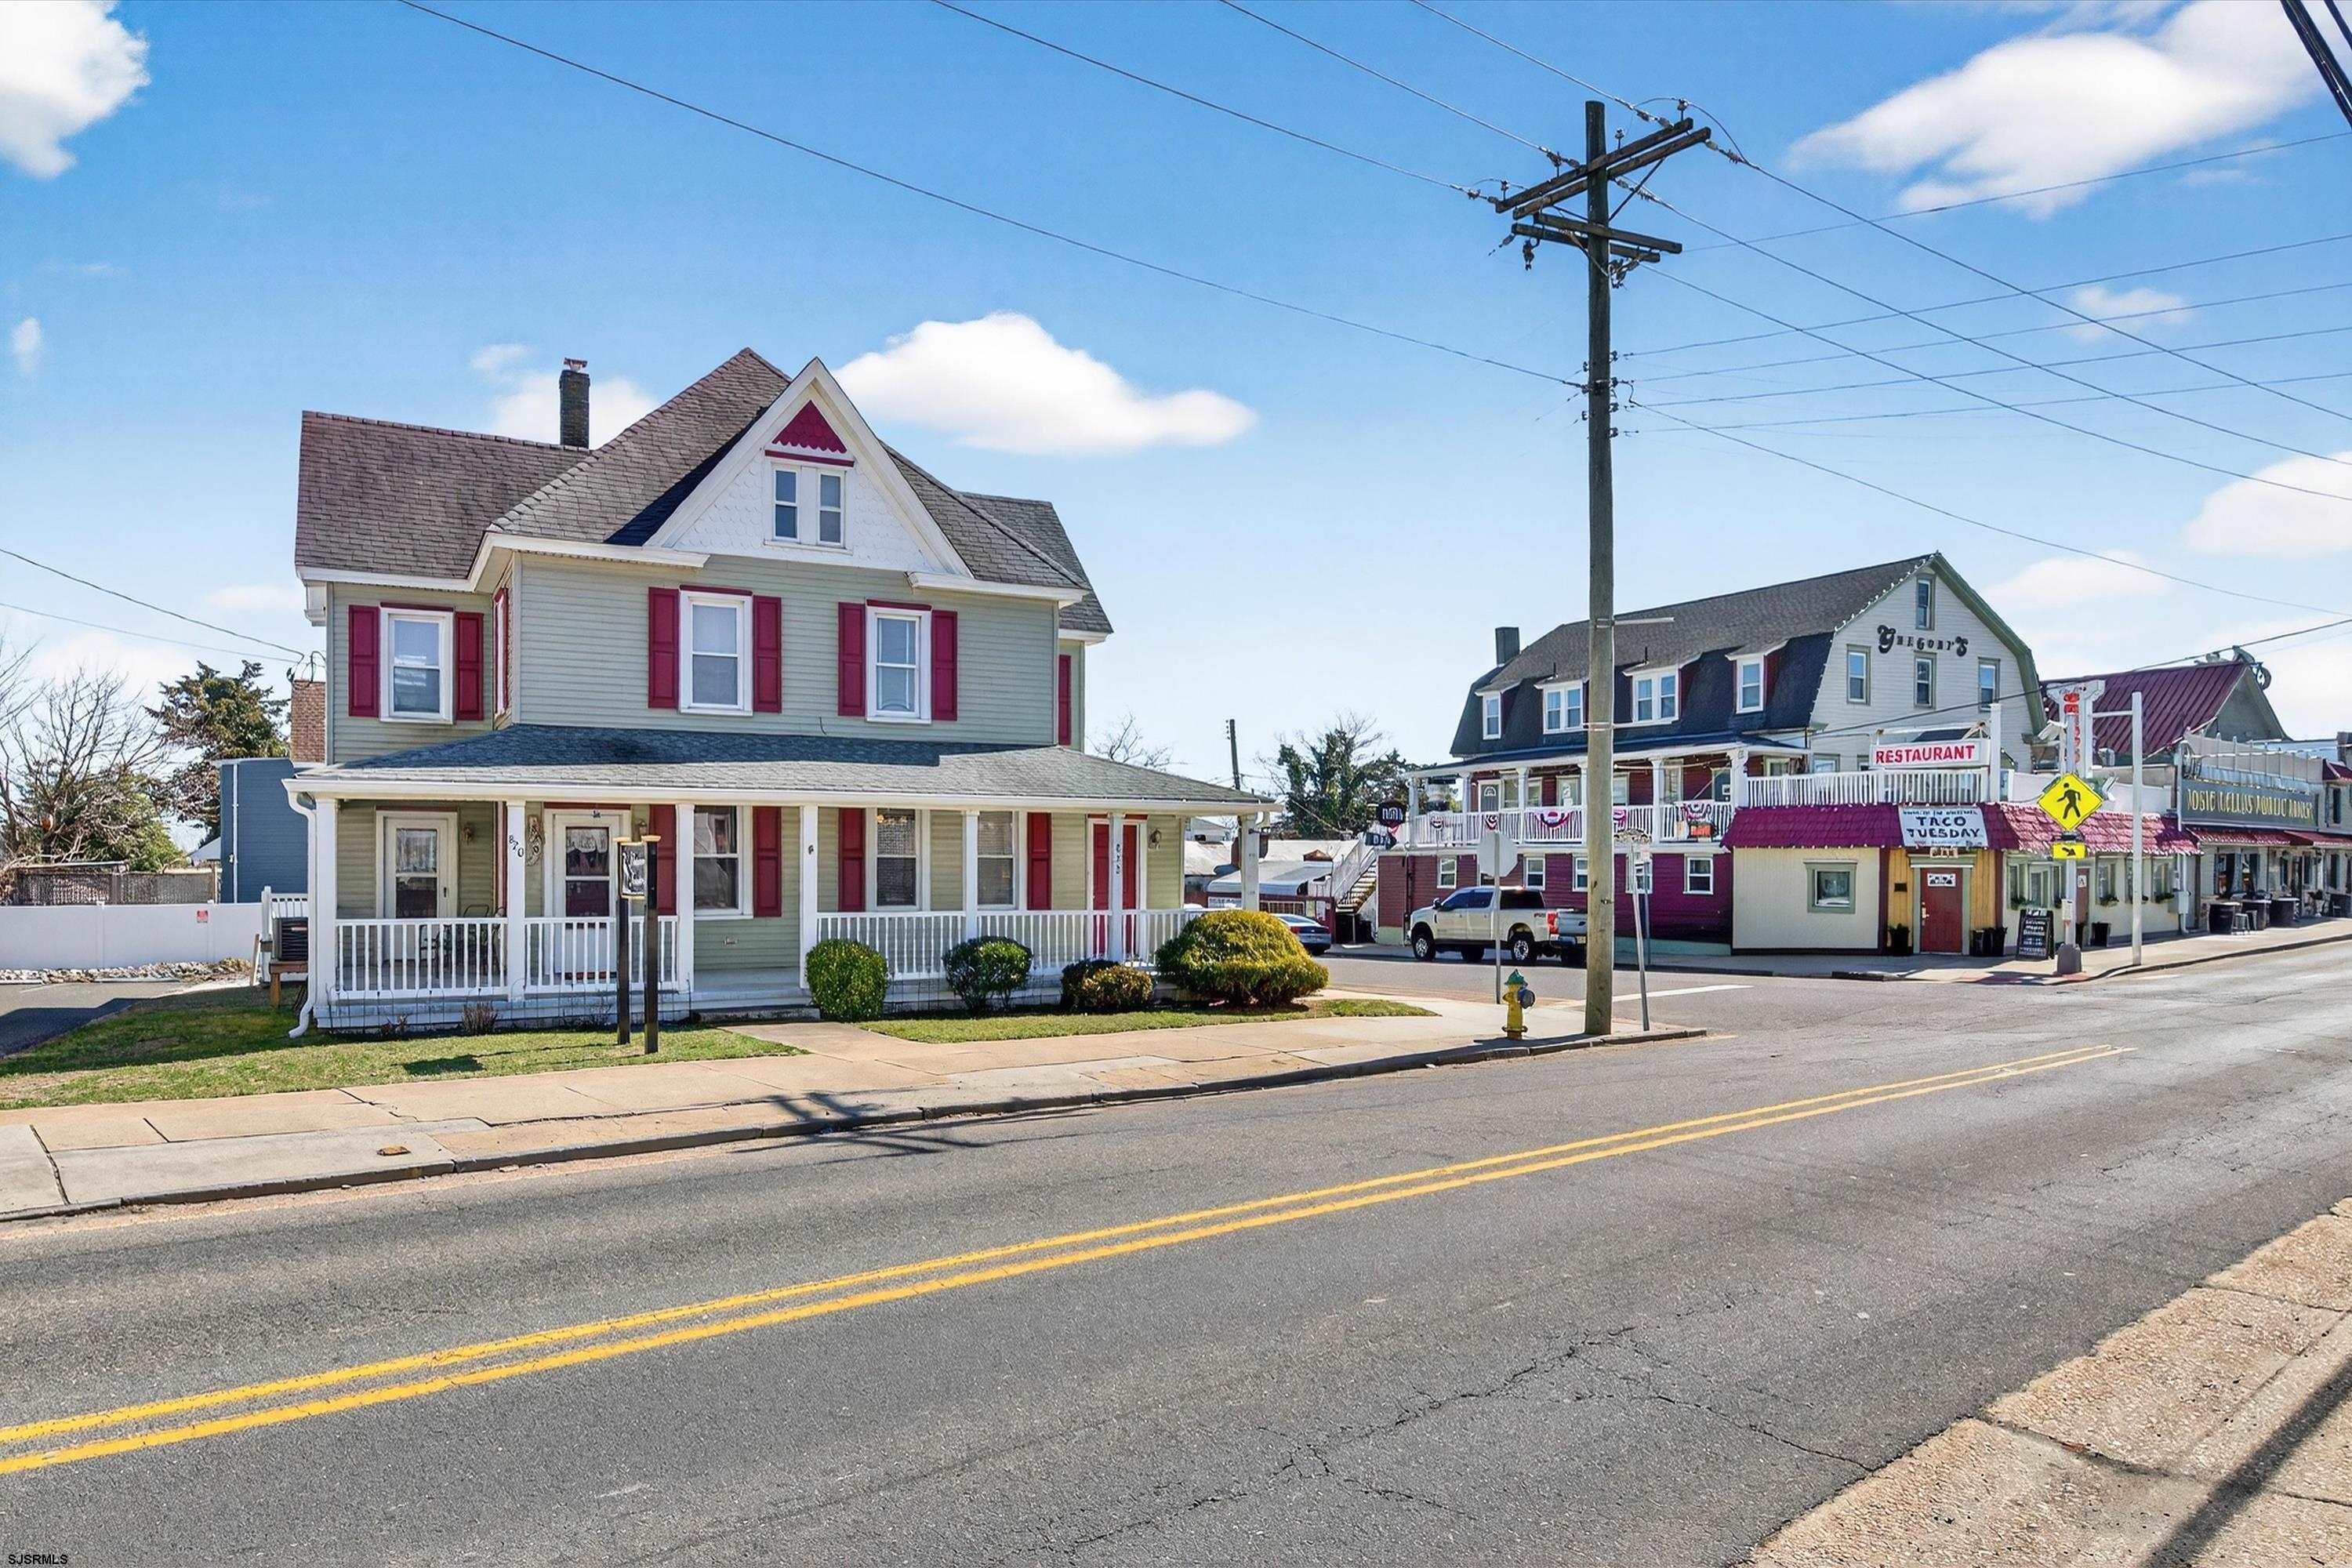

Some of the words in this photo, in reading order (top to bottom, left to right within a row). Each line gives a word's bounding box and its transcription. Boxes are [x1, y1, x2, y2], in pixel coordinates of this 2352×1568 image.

[1875, 745, 1975, 764] RESTAURANT
[1915, 816, 1966, 826] TACO
[1906, 828, 1980, 838] TUESDAY
[509, 835, 524, 858] 870
